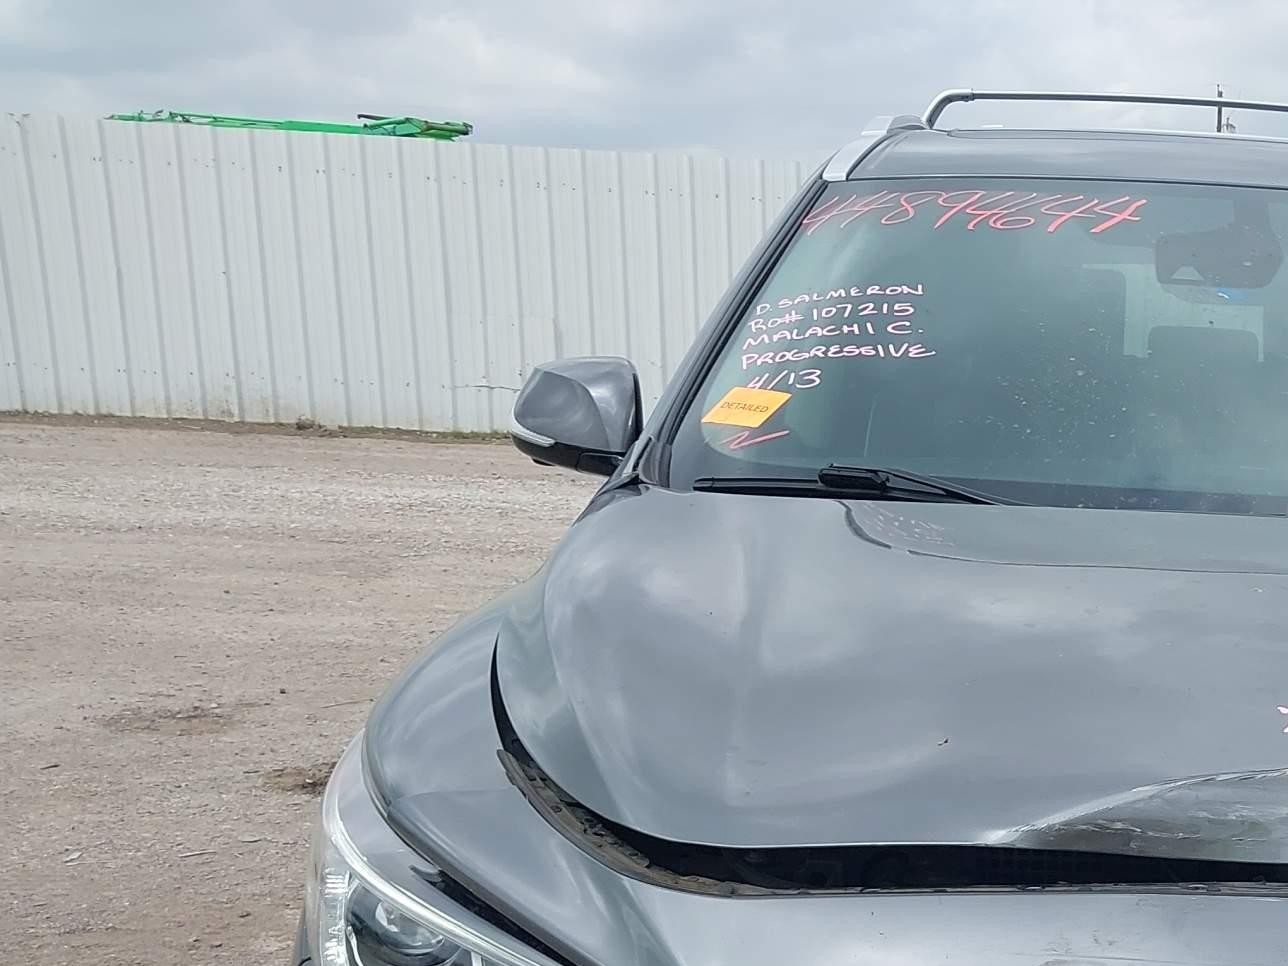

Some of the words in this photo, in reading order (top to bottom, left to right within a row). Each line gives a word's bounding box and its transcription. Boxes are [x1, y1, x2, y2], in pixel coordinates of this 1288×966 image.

[801, 189, 1148, 235] 44894644
[778, 284, 925, 309] SALMERON
[811, 302, 915, 321] 107215
[743, 322, 875, 350] MALACHI
[886, 321, 925, 334] C.
[742, 343, 936, 370] PROGRESSIVE
[747, 368, 822, 389] 4/13
[720, 401, 769, 413] DETAILED
